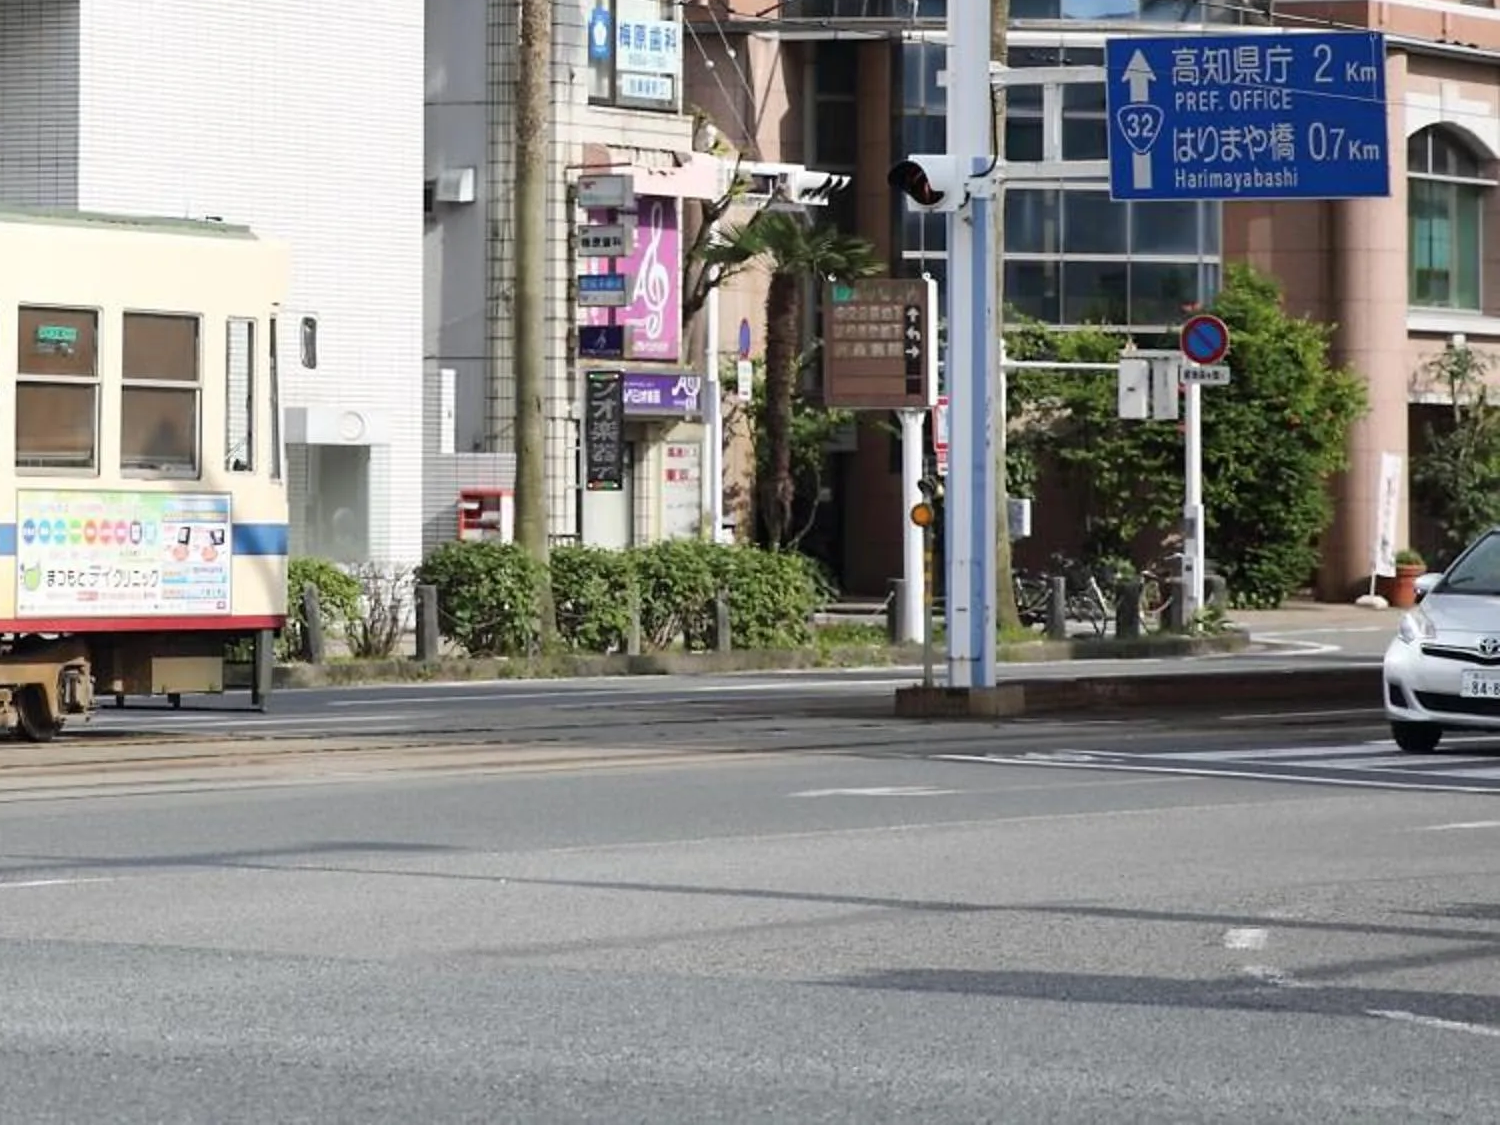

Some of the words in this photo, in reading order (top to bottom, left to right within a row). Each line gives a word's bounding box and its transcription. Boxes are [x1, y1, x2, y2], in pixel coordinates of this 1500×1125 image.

[1171, 44, 1294, 86] 高知県庁
[1313, 43, 1334, 83] 2
[1345, 61, 1377, 82] Km
[1175, 90, 1224, 112] PREF.
[1229, 88, 1293, 111] OFFICE
[1126, 113, 1153, 137] 32
[1172, 122, 1295, 163] はりまや橋
[1349, 140, 1380, 161] Km
[1175, 168, 1299, 193] Harimayabashi
[46, 564, 160, 588] まつもとデイクリニック
